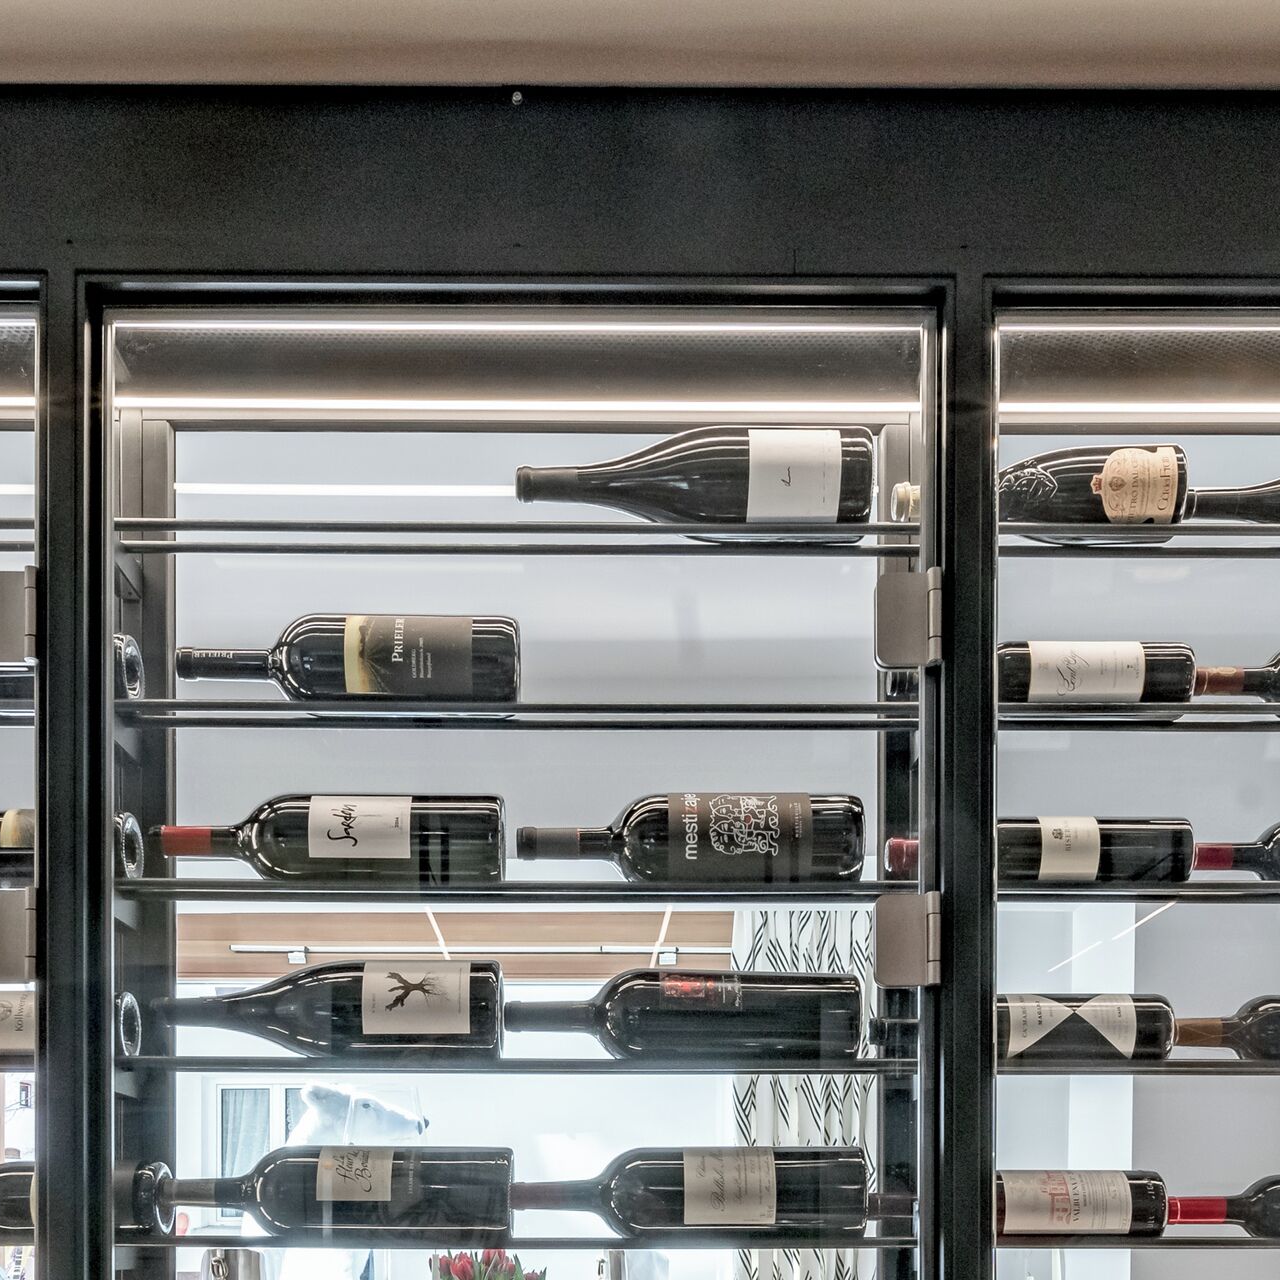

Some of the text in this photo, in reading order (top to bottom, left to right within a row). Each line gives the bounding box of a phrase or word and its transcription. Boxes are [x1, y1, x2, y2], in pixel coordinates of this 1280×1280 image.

[192, 651, 234, 660] PRIELER
[391, 617, 406, 662] PRIELER
[680, 793, 699, 860] mestizaje
